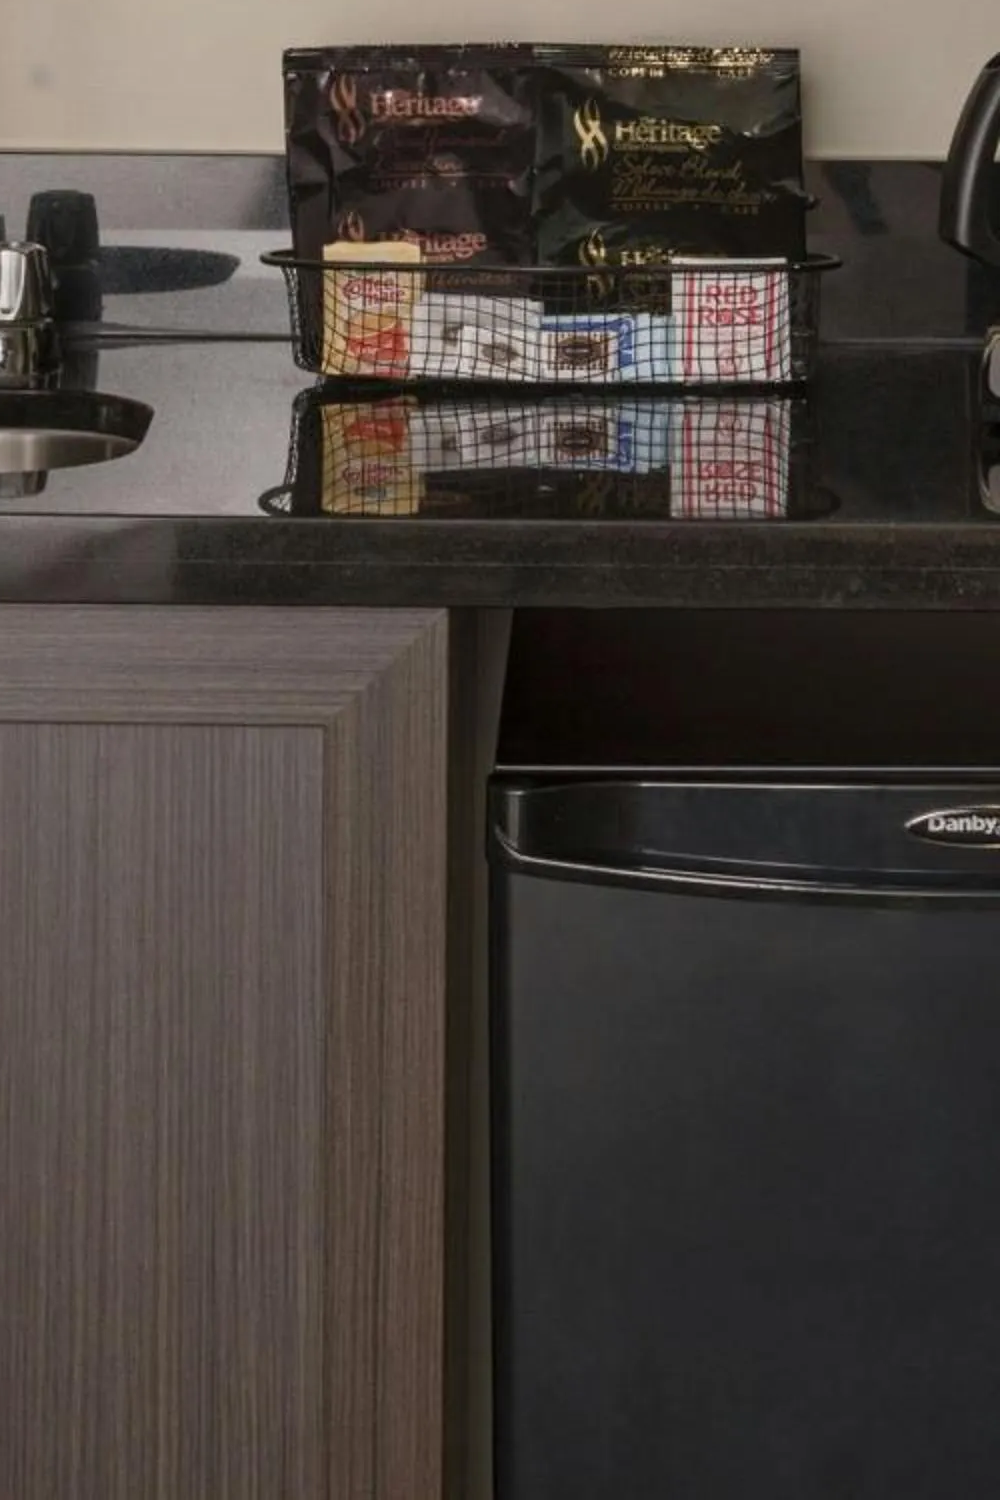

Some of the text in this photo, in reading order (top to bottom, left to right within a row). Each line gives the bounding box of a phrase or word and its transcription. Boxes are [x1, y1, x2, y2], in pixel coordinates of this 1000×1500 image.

[615, 119, 722, 150] Heritage
[704, 284, 758, 305] RED
[699, 305, 762, 325] ROSE
[927, 815, 997, 835] Danby
